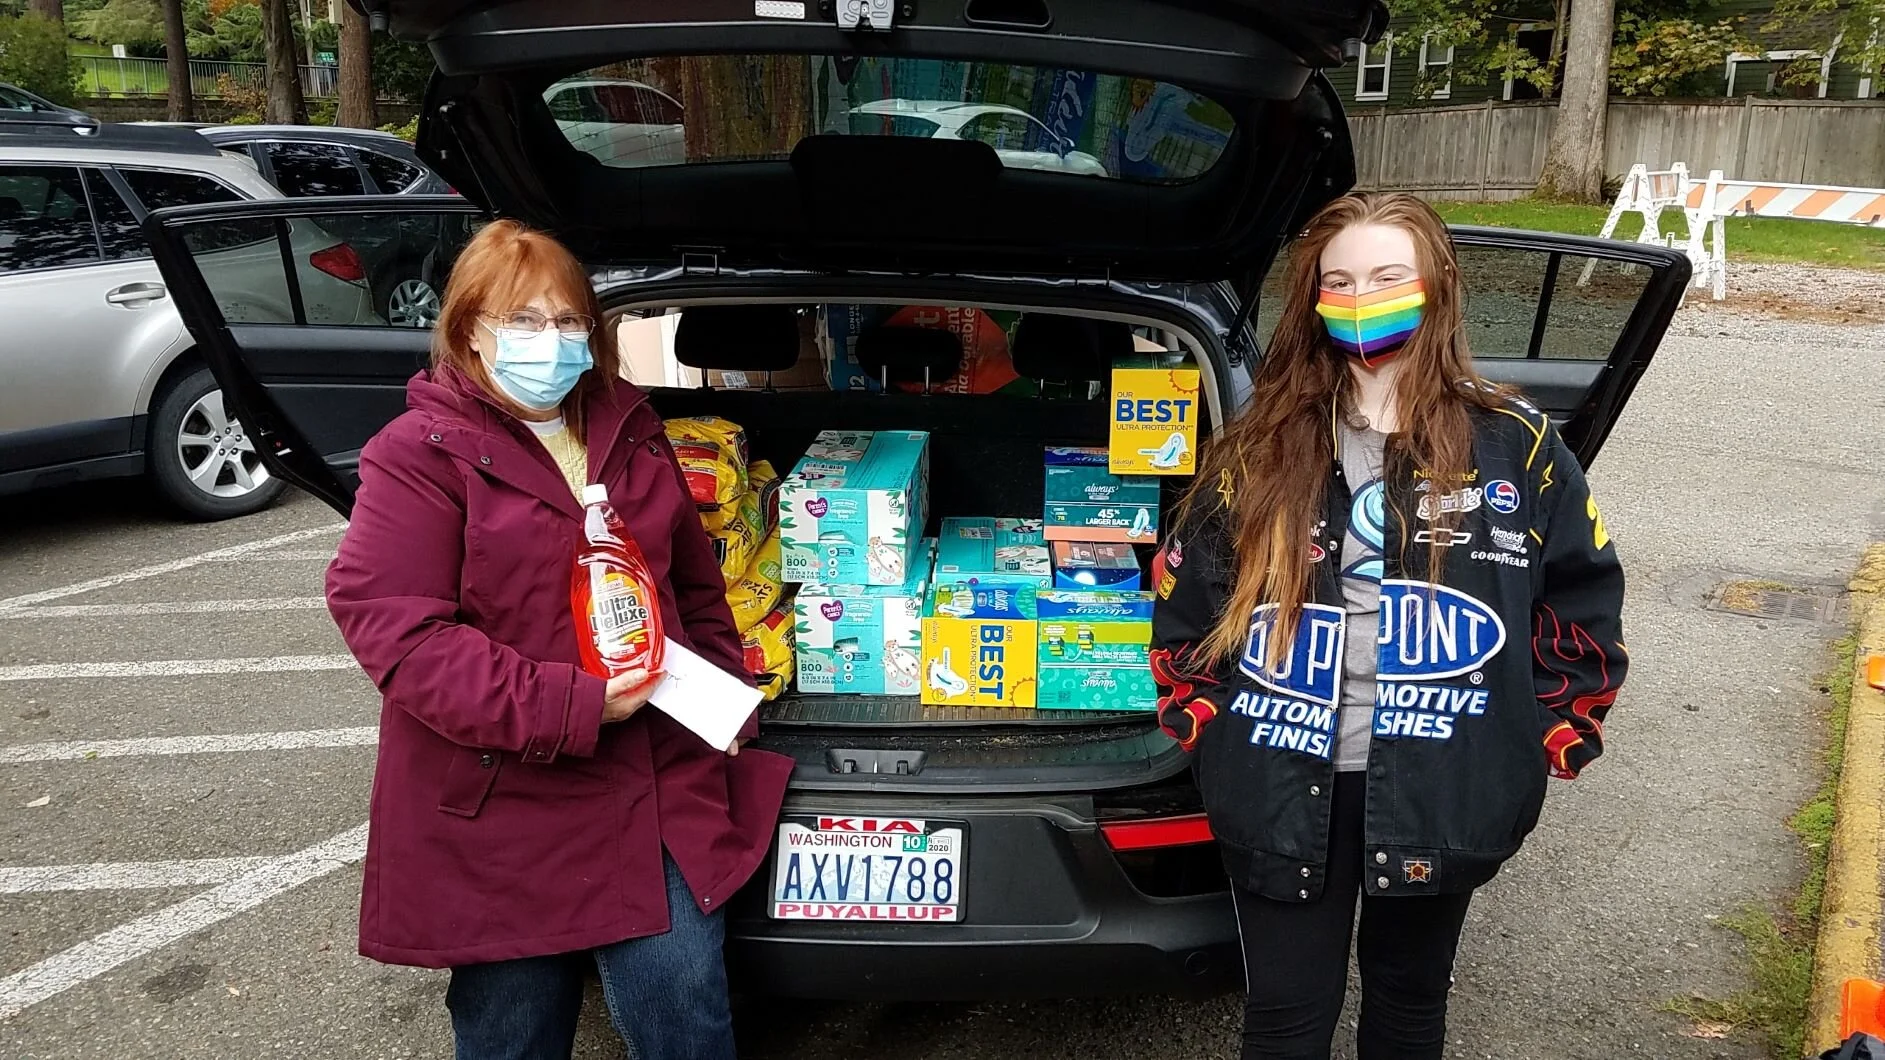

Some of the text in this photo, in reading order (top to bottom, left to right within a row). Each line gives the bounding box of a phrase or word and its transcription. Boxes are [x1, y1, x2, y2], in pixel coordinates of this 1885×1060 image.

[1116, 399, 1192, 422] BEST
[1084, 483, 1117, 496] always
[1490, 497, 1516, 509] PEPSI
[1085, 518, 1111, 526] LARGER
[1490, 525, 1527, 545] Hendrick
[786, 558, 807, 567] 800
[1470, 550, 1530, 568] GOODYEAR
[599, 594, 638, 617] Ultra
[1066, 606, 1134, 616] always
[970, 625, 978, 650] ULTRA
[800, 663, 822, 672] 800
[978, 625, 1005, 700] BEST
[1081, 676, 1117, 688] always
[1376, 683, 1490, 715] MOTIVE
[819, 817, 921, 833] KIA
[789, 833, 893, 849] WASHINGTON
[903, 836, 920, 849] 10
[927, 844, 950, 852] 2020
[782, 852, 953, 905] AXV1788
[778, 904, 954, 920] PUYALLUP
